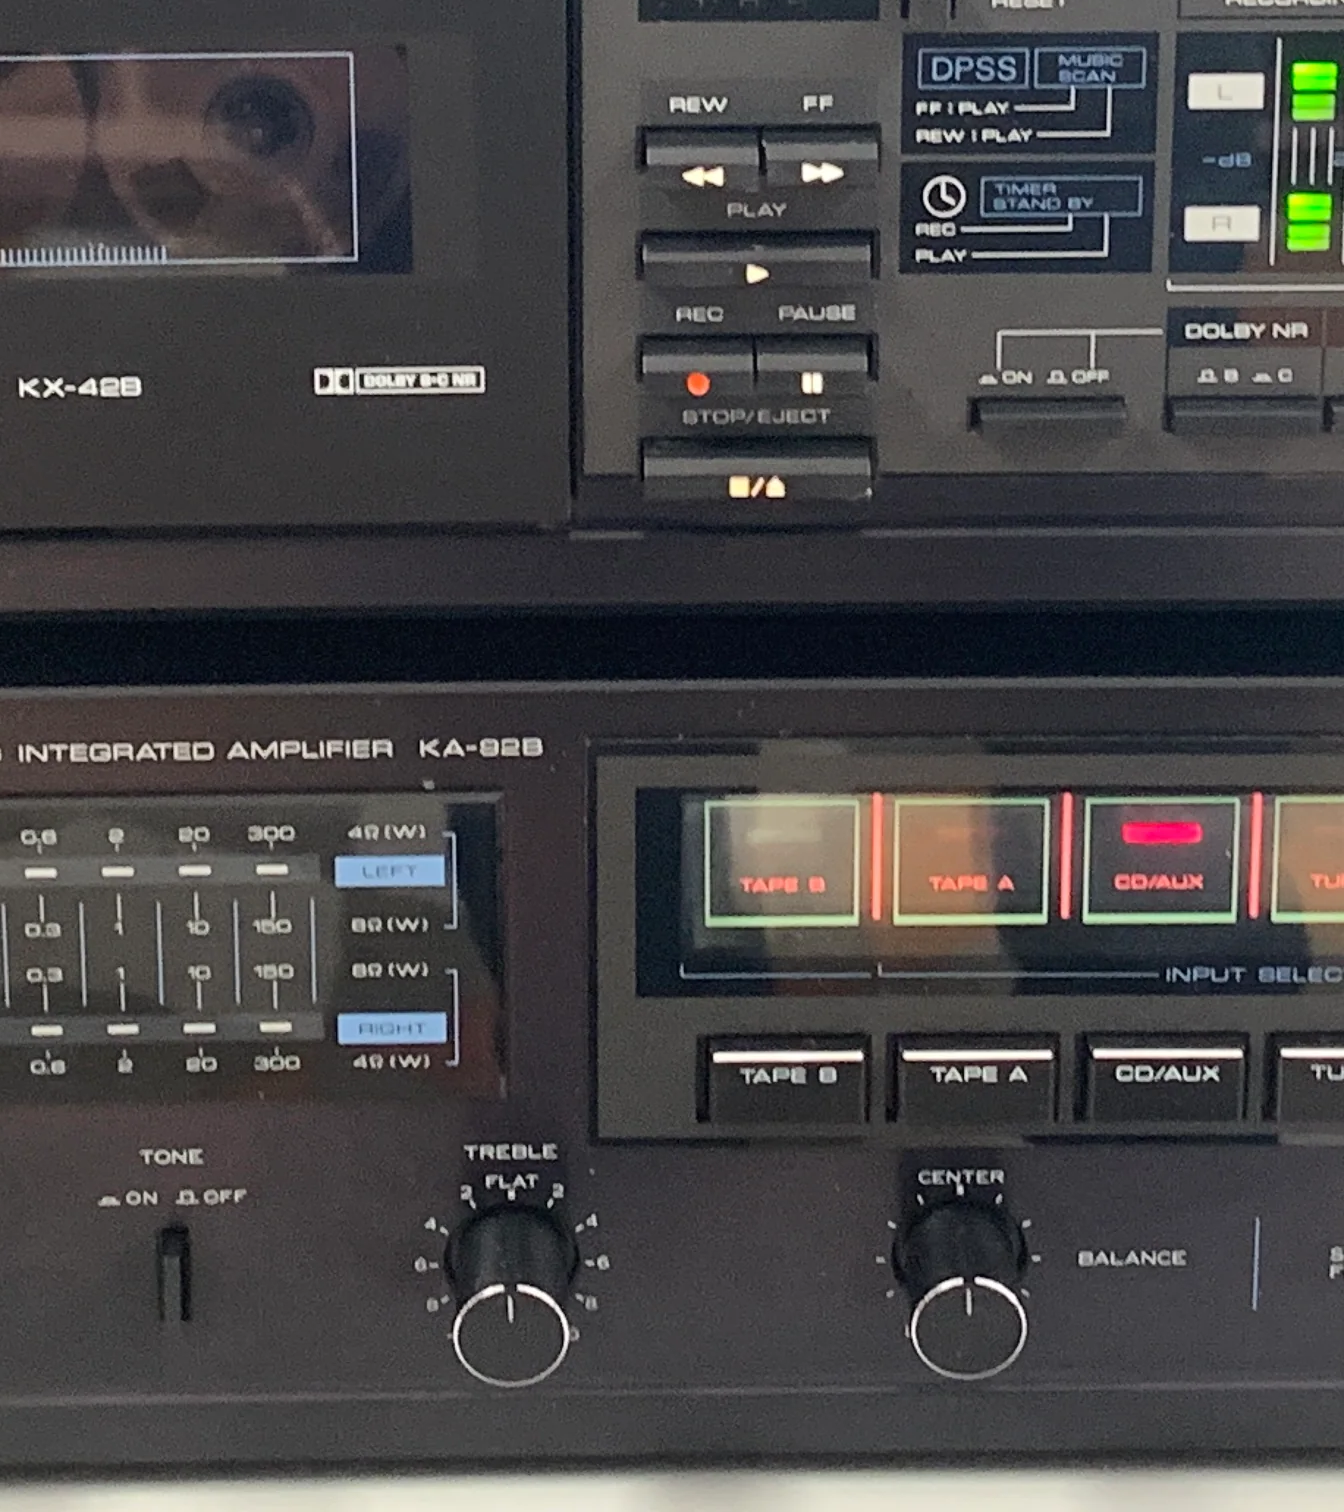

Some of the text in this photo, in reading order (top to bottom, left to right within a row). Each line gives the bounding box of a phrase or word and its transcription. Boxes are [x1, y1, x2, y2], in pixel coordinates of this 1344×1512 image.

[1058, 51, 1124, 68] MUSIC
[930, 53, 1017, 84] DPSS
[1058, 68, 1117, 85] SCAN
[670, 97, 727, 113] REW
[804, 95, 833, 111] FF
[994, 180, 1057, 196] TIMER
[727, 203, 786, 217] PLAY
[992, 196, 1059, 213] STAND
[916, 249, 967, 263] PLAY
[676, 307, 723, 322] REC
[779, 305, 855, 320] PAUSE
[1185, 323, 1308, 339] DOLBY NR
[19, 377, 141, 398] KX-42B
[683, 408, 831, 425] STOP/EJECT
[19, 742, 214, 762] INTEGRATED
[227, 740, 392, 759] AMPLIFIER
[362, 864, 416, 879] LEFT
[740, 877, 798, 893] TAPE
[929, 875, 989, 891] TAPE
[1115, 874, 1203, 890] CD/AUX
[1166, 966, 1246, 982] INPUT
[359, 1023, 426, 1035] RIGHT
[741, 1067, 806, 1084] TAPE
[930, 1066, 1027, 1082] TAPE A
[1116, 1065, 1219, 1082] CD/AUX
[140, 1149, 203, 1164] TONE
[464, 1144, 557, 1160] TREBLE
[486, 1174, 538, 1192] FLAT
[918, 1170, 1004, 1186] CENTER
[1079, 1250, 1186, 1266] BALANCE
